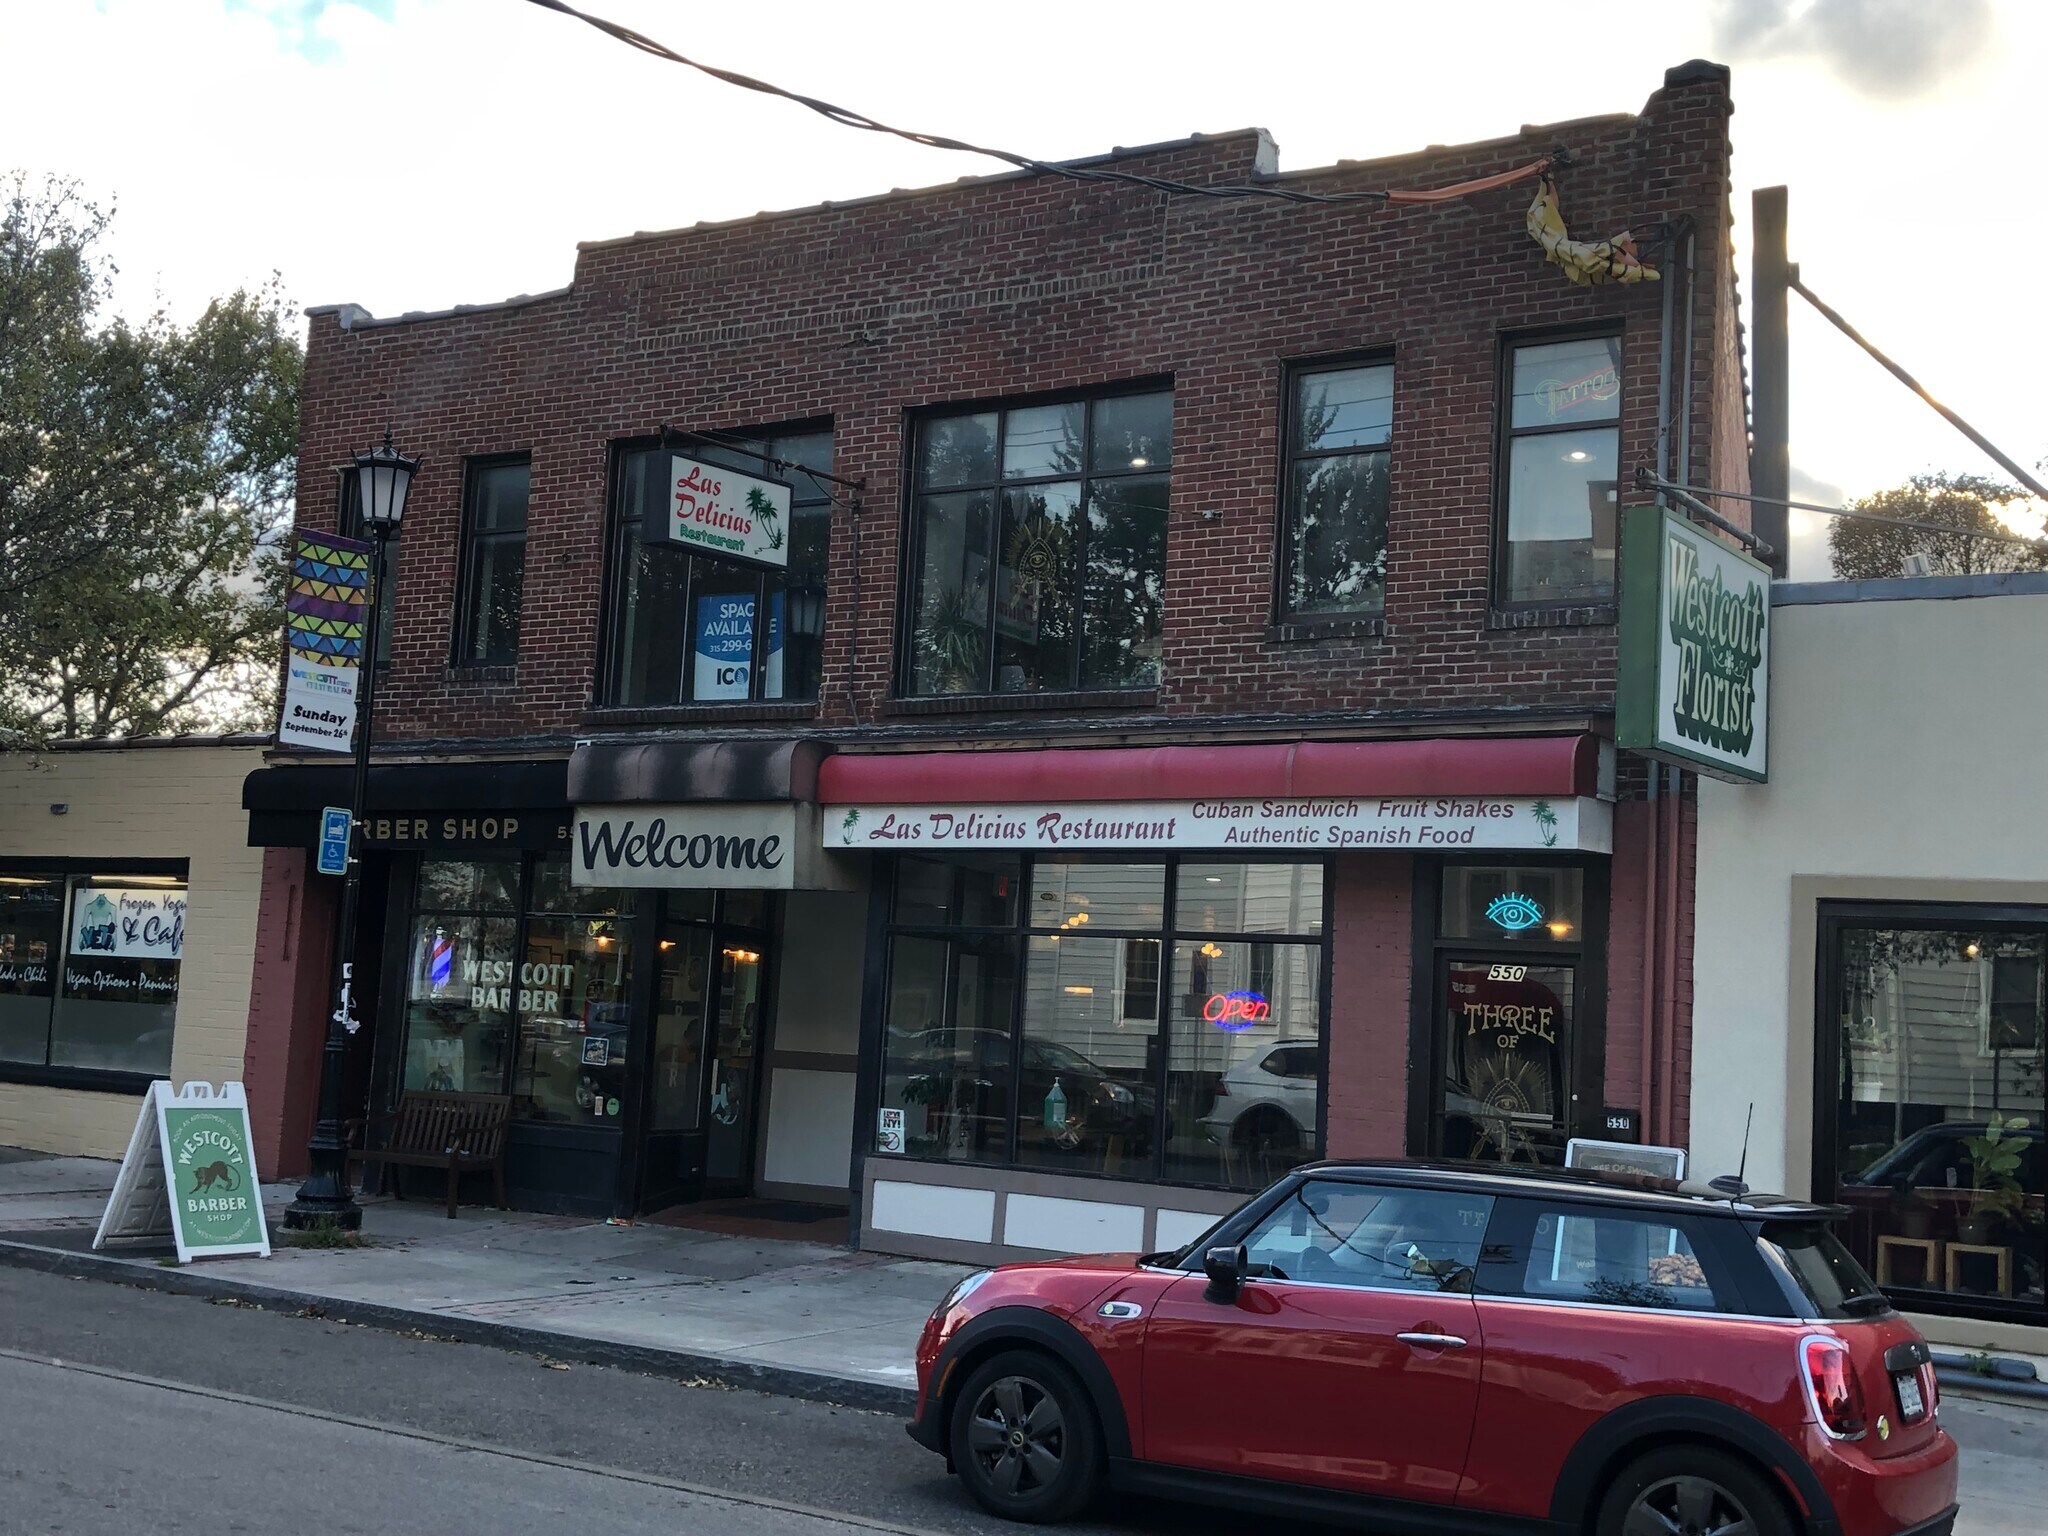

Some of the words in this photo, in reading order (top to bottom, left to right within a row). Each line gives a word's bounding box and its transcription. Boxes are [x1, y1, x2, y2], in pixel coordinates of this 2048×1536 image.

[1535, 370, 1620, 420] TATTOO
[677, 466, 721, 496] Las
[675, 492, 751, 534] Delicias
[680, 523, 745, 551] Restaurant
[1669, 537, 1762, 657] Westcott
[720, 602, 755, 618] SPAC
[704, 618, 777, 636] AVAILAE
[717, 667, 749, 685] ICO
[1675, 637, 1751, 737] Florist
[293, 704, 347, 727] Sunday
[285, 721, 332, 737] September
[1192, 801, 1254, 819] Cuban
[1260, 799, 1358, 818] Sandwich
[1377, 800, 1428, 818] Fruit
[1434, 799, 1514, 818] Shakes
[363, 819, 428, 840] RBER
[443, 818, 519, 839] SHOP
[869, 814, 921, 841] Las
[930, 813, 1026, 841] Delicias
[1036, 812, 1177, 844] Restaurant
[1224, 825, 1320, 843] Authentic
[1327, 825, 1411, 847] Spanish
[1418, 826, 1475, 844] Food
[579, 818, 785, 870] Welcome
[120, 892, 156, 916] Frozen
[163, 894, 187, 917] Yogu
[24, 966, 47, 982] Chili
[66, 967, 91, 991] Vegan
[93, 970, 130, 992] Options
[462, 959, 574, 987] WESTCOTT
[1490, 966, 1524, 980] 550
[471, 987, 559, 1012] BARBER
[1203, 993, 1269, 1023] Open
[1463, 1001, 1555, 1044] THREE
[1496, 1034, 1519, 1048] OF
[1608, 1117, 1630, 1129] 550
[178, 1130, 244, 1165] WESTCOTT
[187, 1197, 247, 1212] BARBER
[207, 1213, 233, 1222] SHOP
